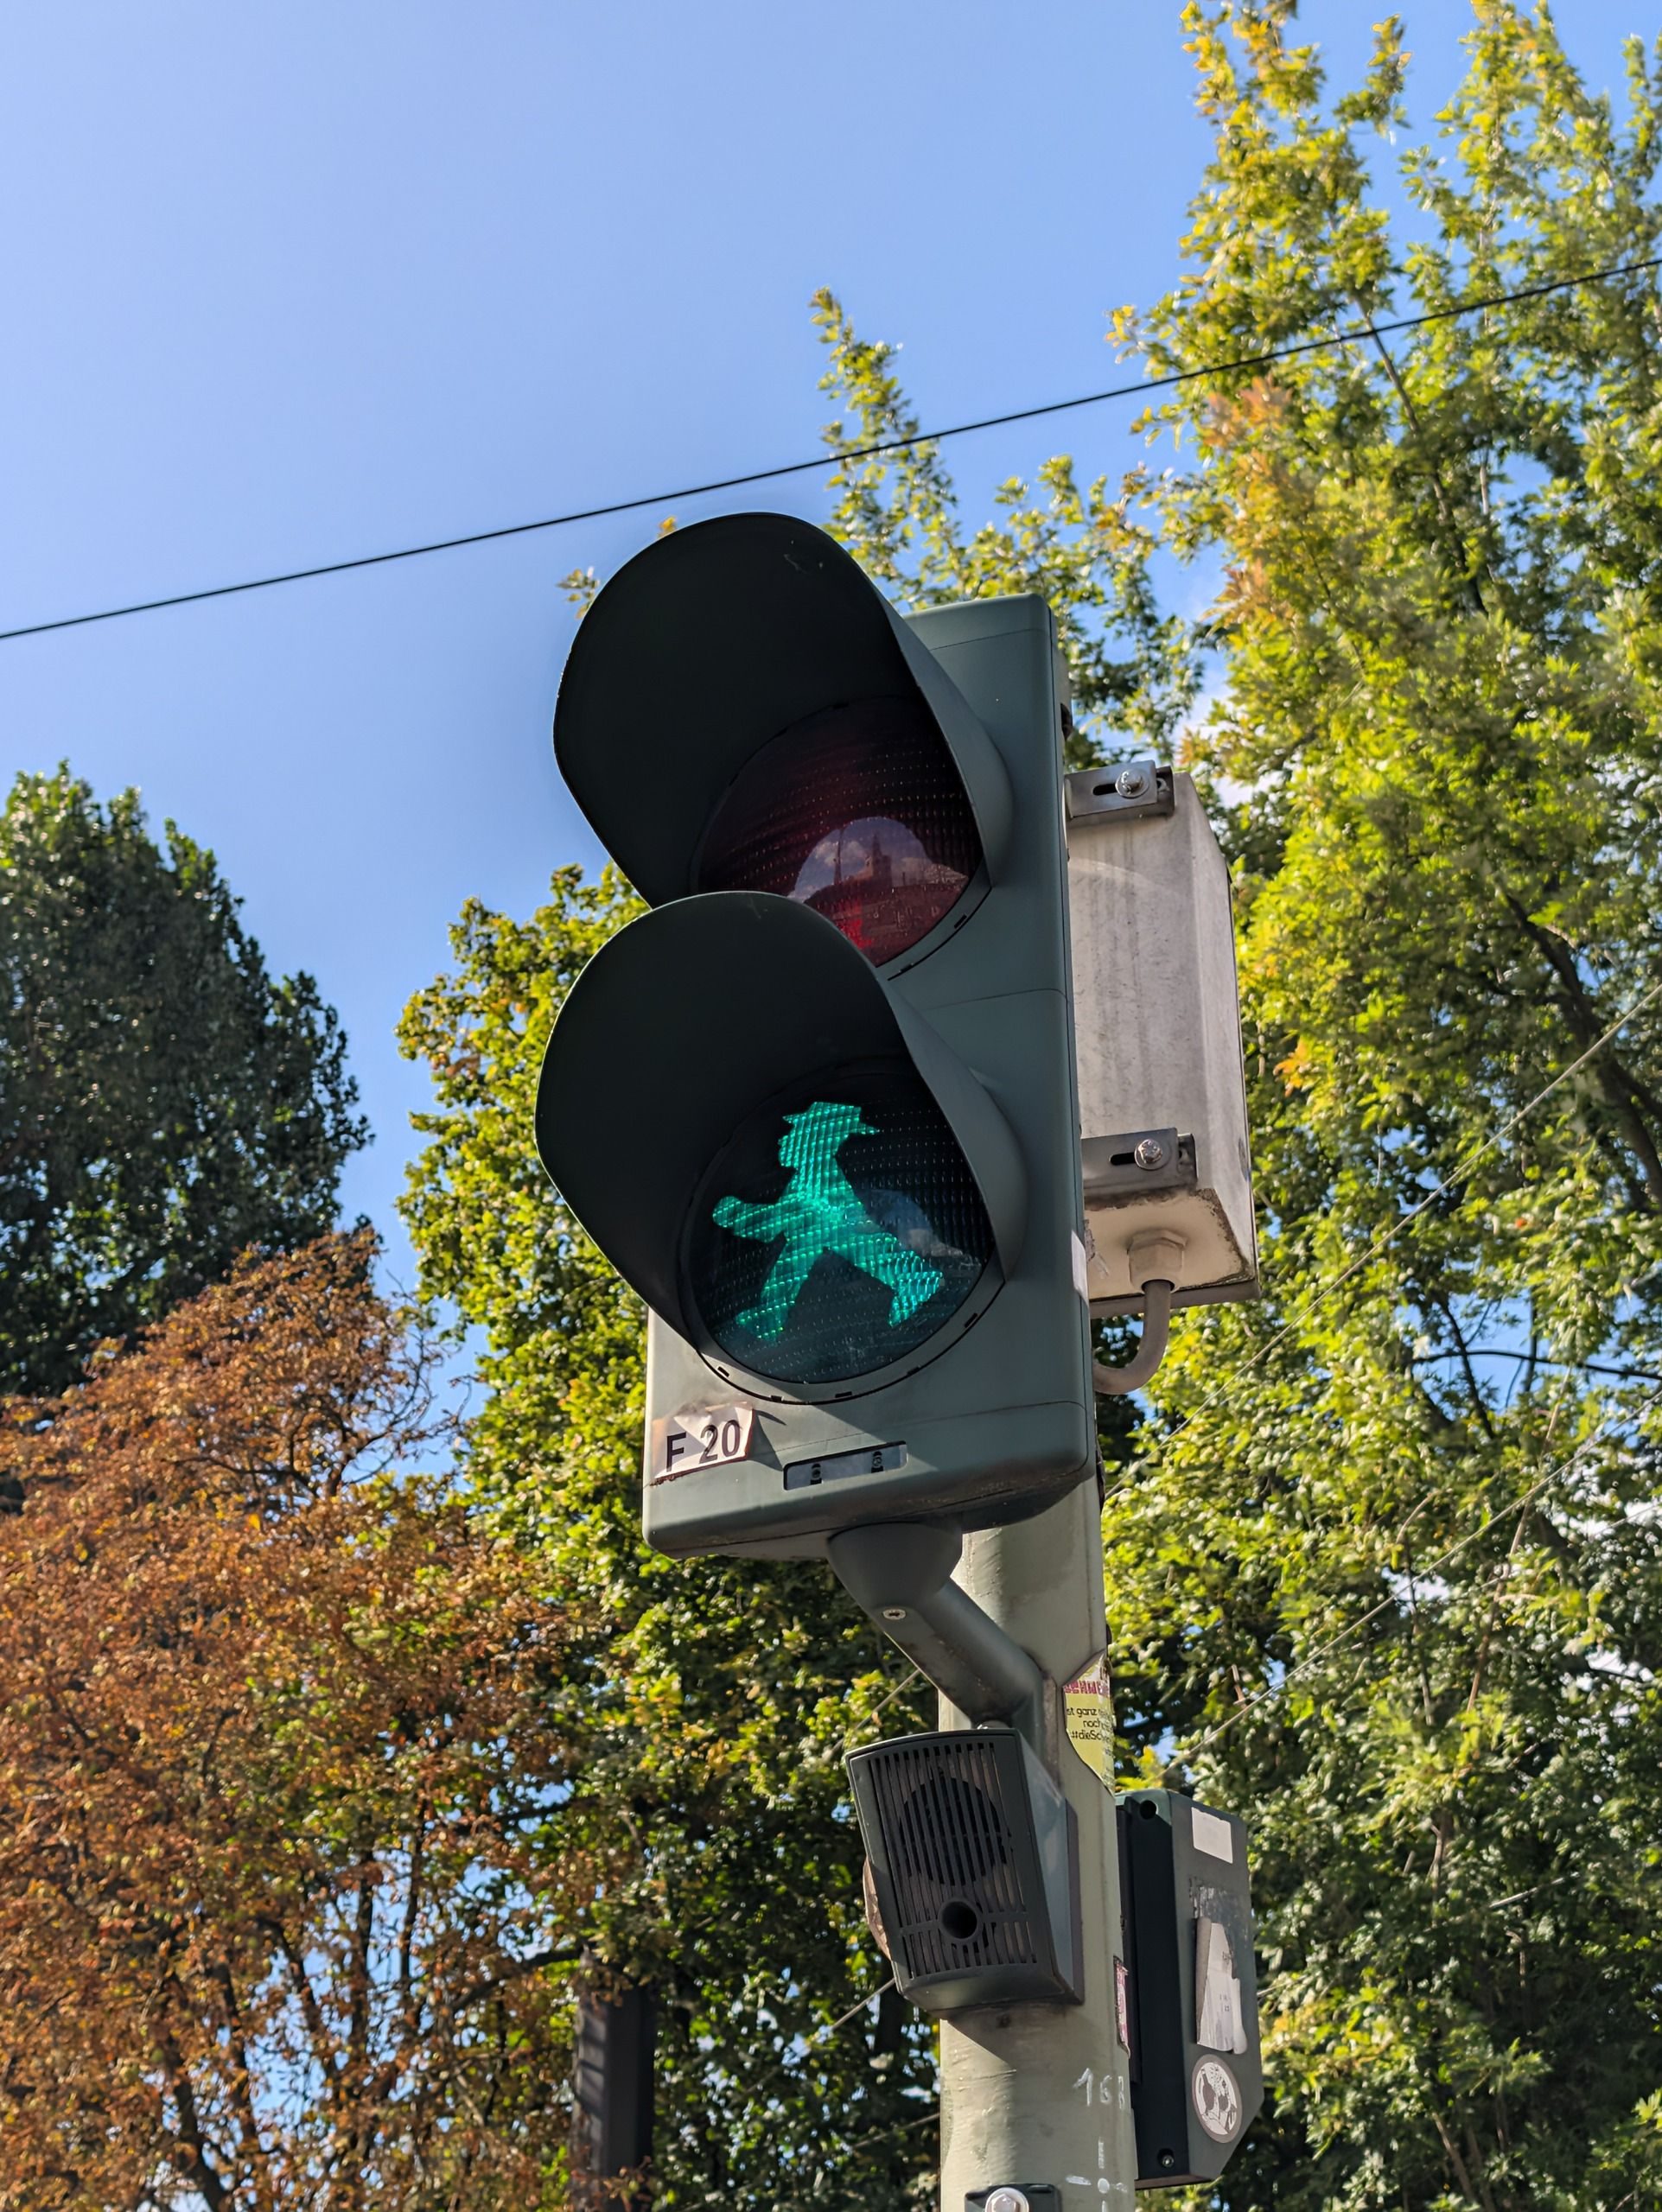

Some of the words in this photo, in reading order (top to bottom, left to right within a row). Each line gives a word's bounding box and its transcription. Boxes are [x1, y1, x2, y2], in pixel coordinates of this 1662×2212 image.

[665, 1431, 687, 1472] F
[698, 1419, 742, 1465] 20
[1076, 1707, 1098, 1719] ganz
